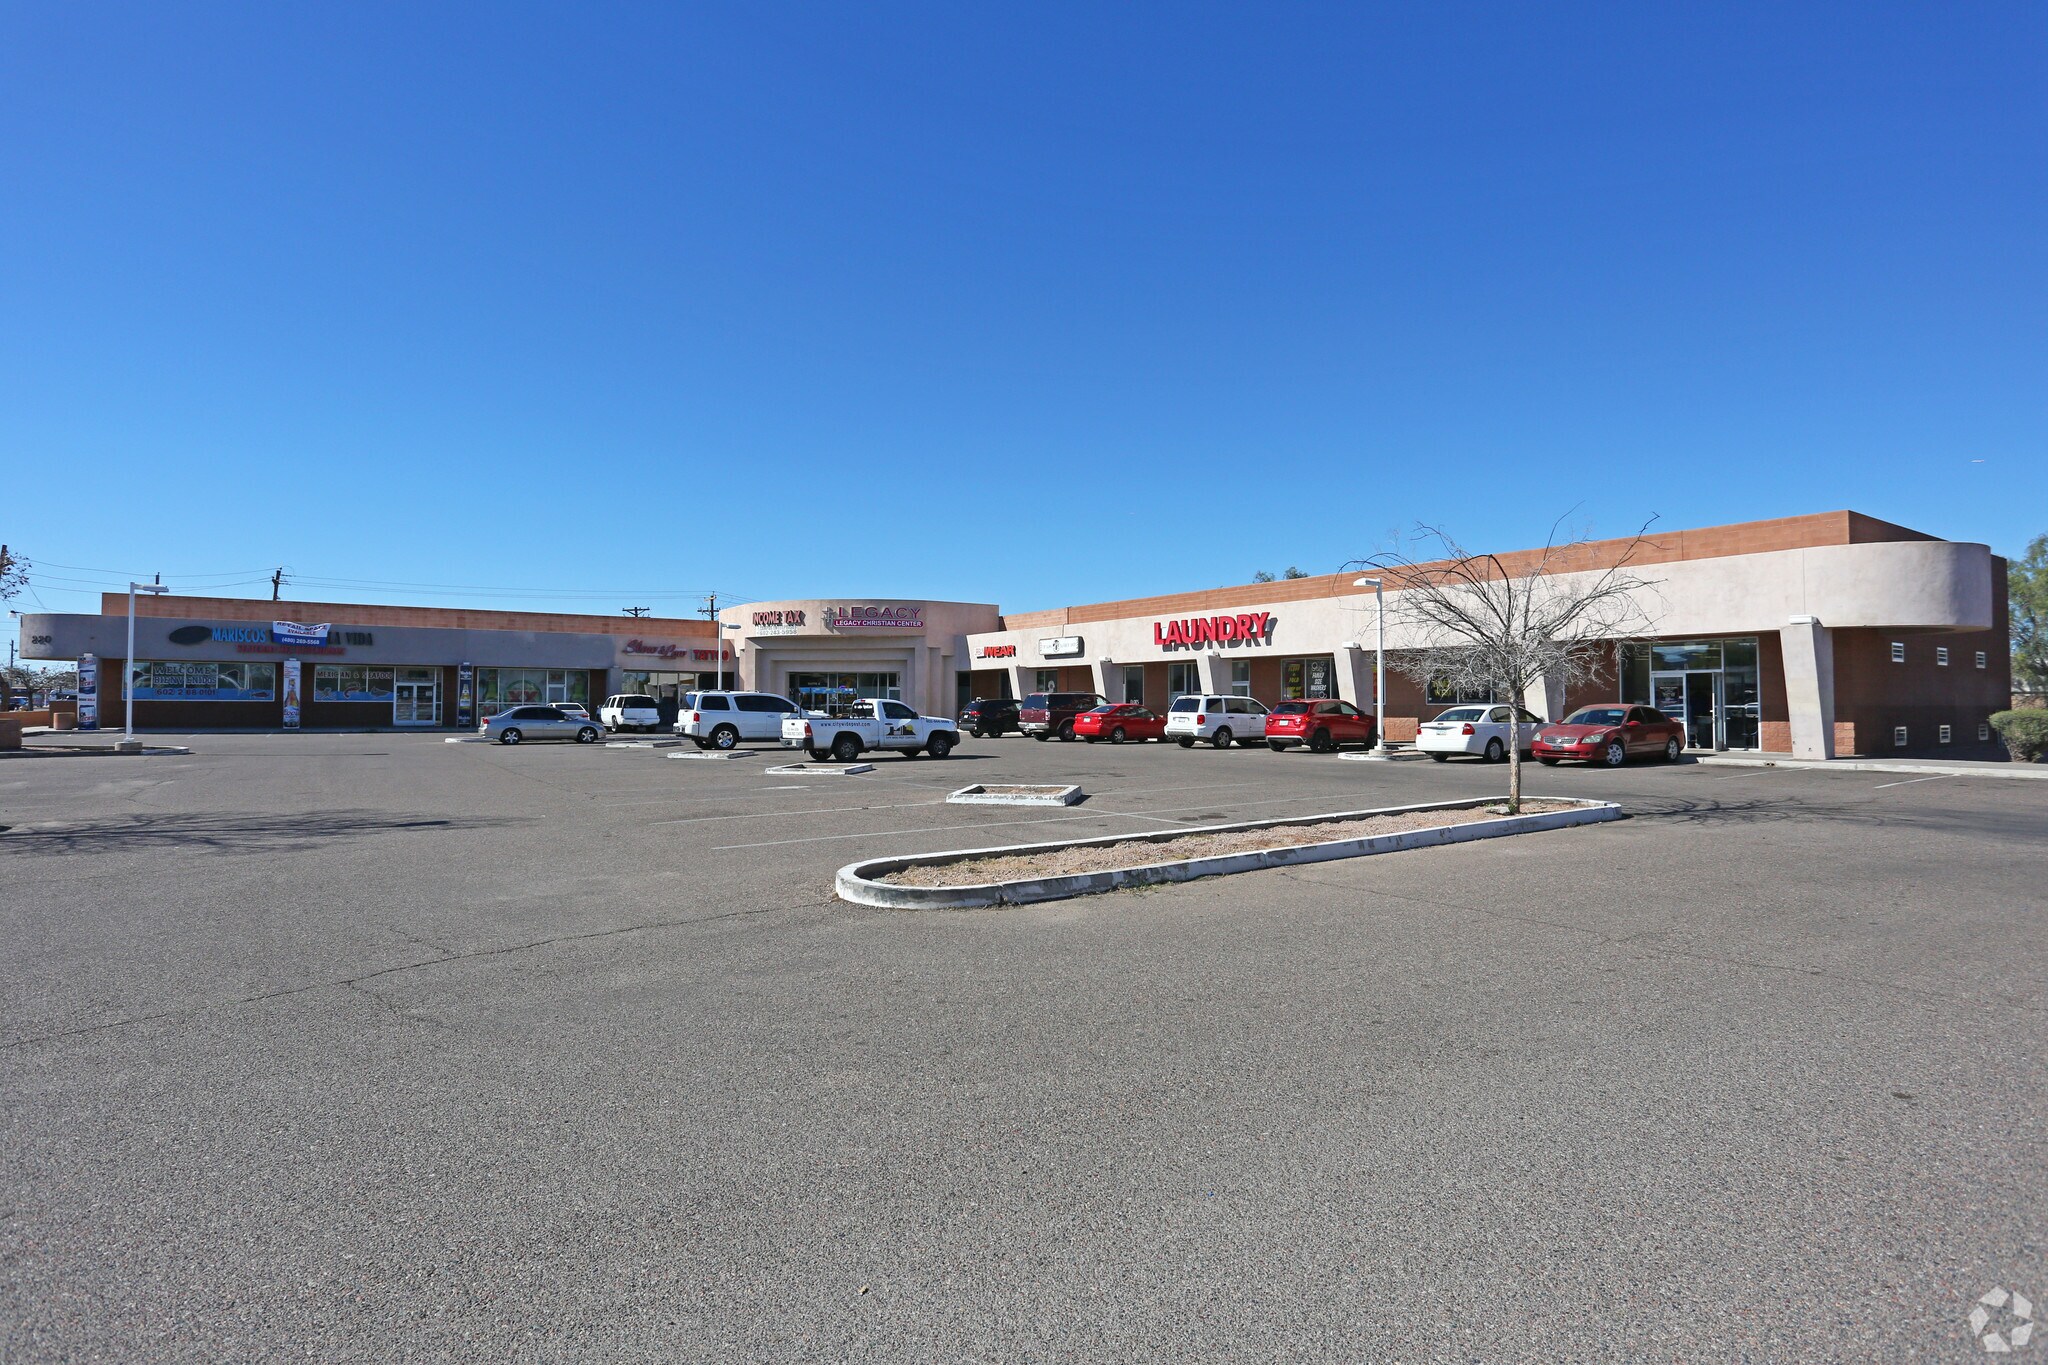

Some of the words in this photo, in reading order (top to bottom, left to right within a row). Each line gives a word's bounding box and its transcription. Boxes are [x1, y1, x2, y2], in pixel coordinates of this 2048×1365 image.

[782, 609, 802, 624] TAX
[838, 606, 921, 619] LEGACY
[897, 620, 922, 628] CENTER
[1154, 611, 1271, 646] LAUNDRY
[211, 627, 267, 643] MARISCOS
[983, 644, 1016, 658] WEAR
[153, 665, 211, 676] WELCOME
[316, 670, 351, 679] MEXICAN
[361, 671, 394, 680] SEAFOOD
[153, 675, 217, 685] BIENVENIDOS
